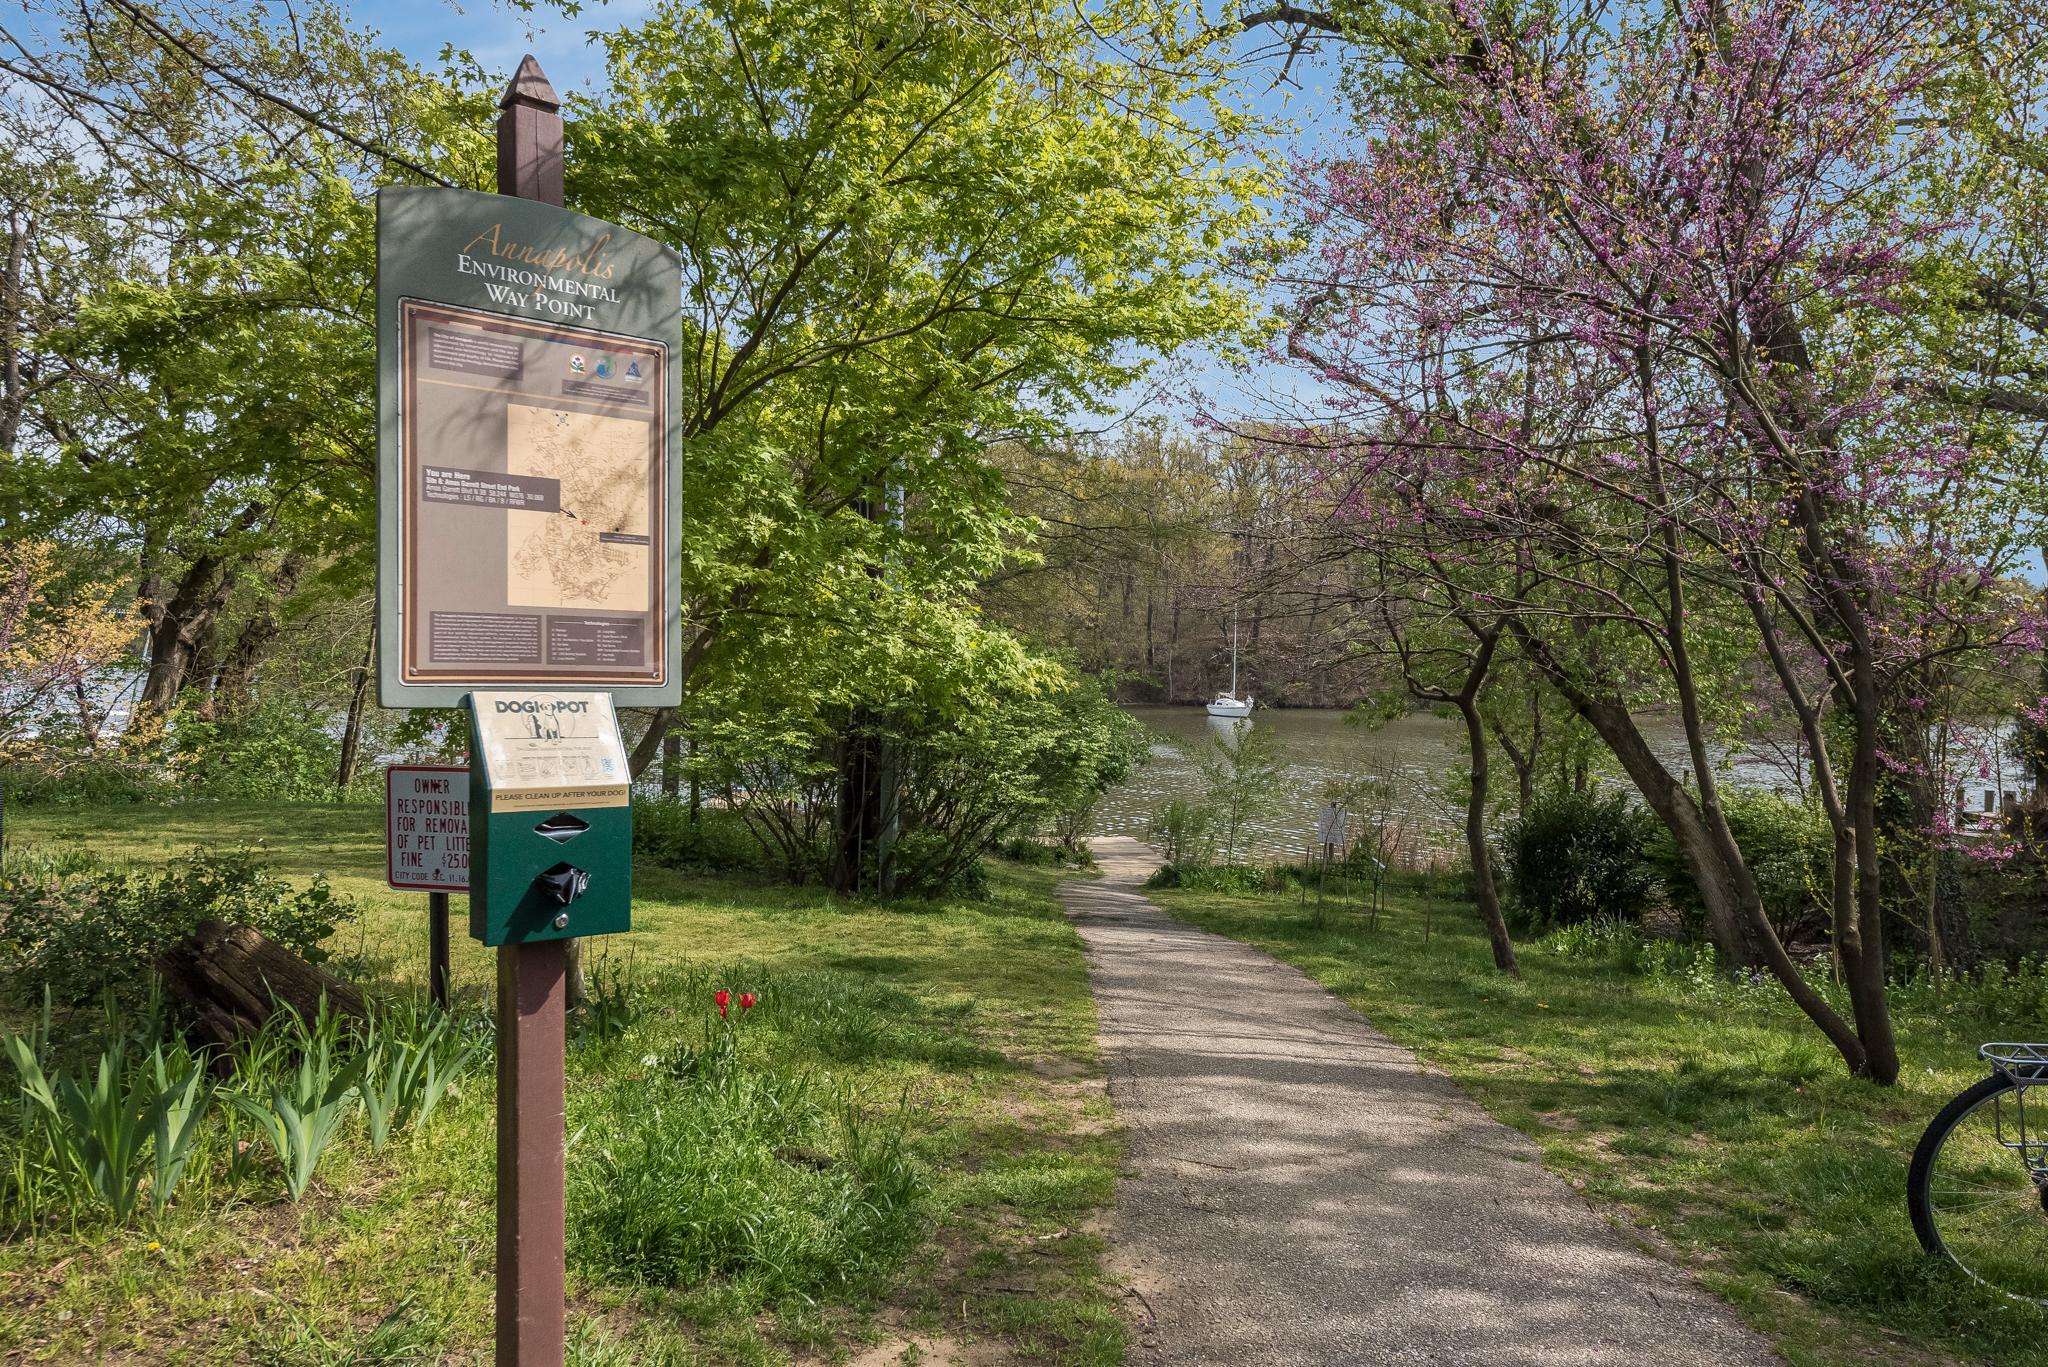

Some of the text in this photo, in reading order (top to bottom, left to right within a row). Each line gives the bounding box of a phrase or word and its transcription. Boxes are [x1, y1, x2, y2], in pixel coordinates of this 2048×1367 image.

[464, 223, 614, 296] Annapolis
[426, 468, 440, 477] You
[441, 471, 452, 479] are
[414, 778, 450, 794] OWNER
[495, 793, 523, 801] PLEASE
[525, 792, 550, 800] CLEAN
[397, 798, 470, 816] RESPONSIBL
[397, 816, 468, 834] FOR REMOVA
[397, 834, 471, 852] OF PET LITTE
[401, 852, 470, 869] FINE $25.0
[411, 872, 428, 881] CODE
